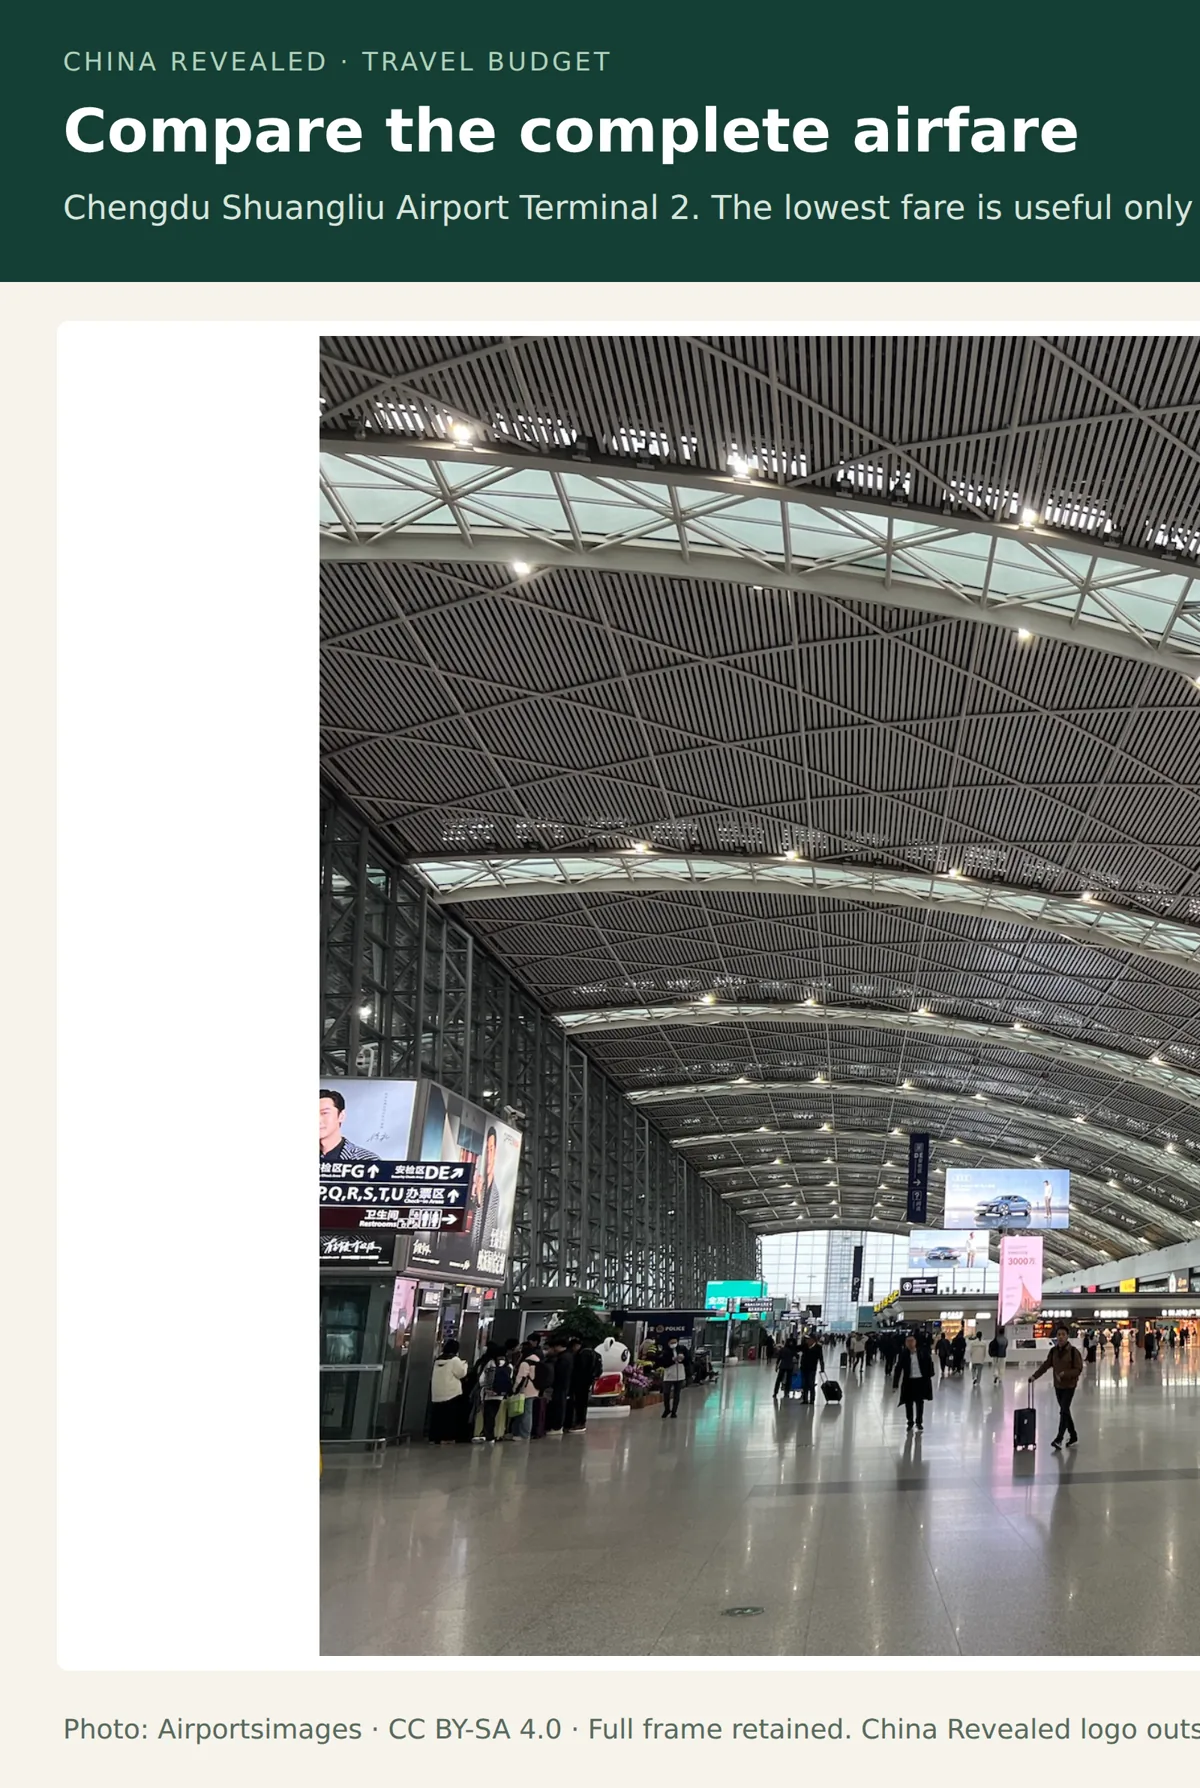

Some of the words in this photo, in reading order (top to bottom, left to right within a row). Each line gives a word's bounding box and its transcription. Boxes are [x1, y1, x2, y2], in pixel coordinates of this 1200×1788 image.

[319, 1163, 342, 1174] 检区
[342, 1164, 364, 1179] FG
[425, 1165, 451, 1180] DE
[406, 1187, 445, 1200] 办票区
[364, 1209, 399, 1221] 卫生间
